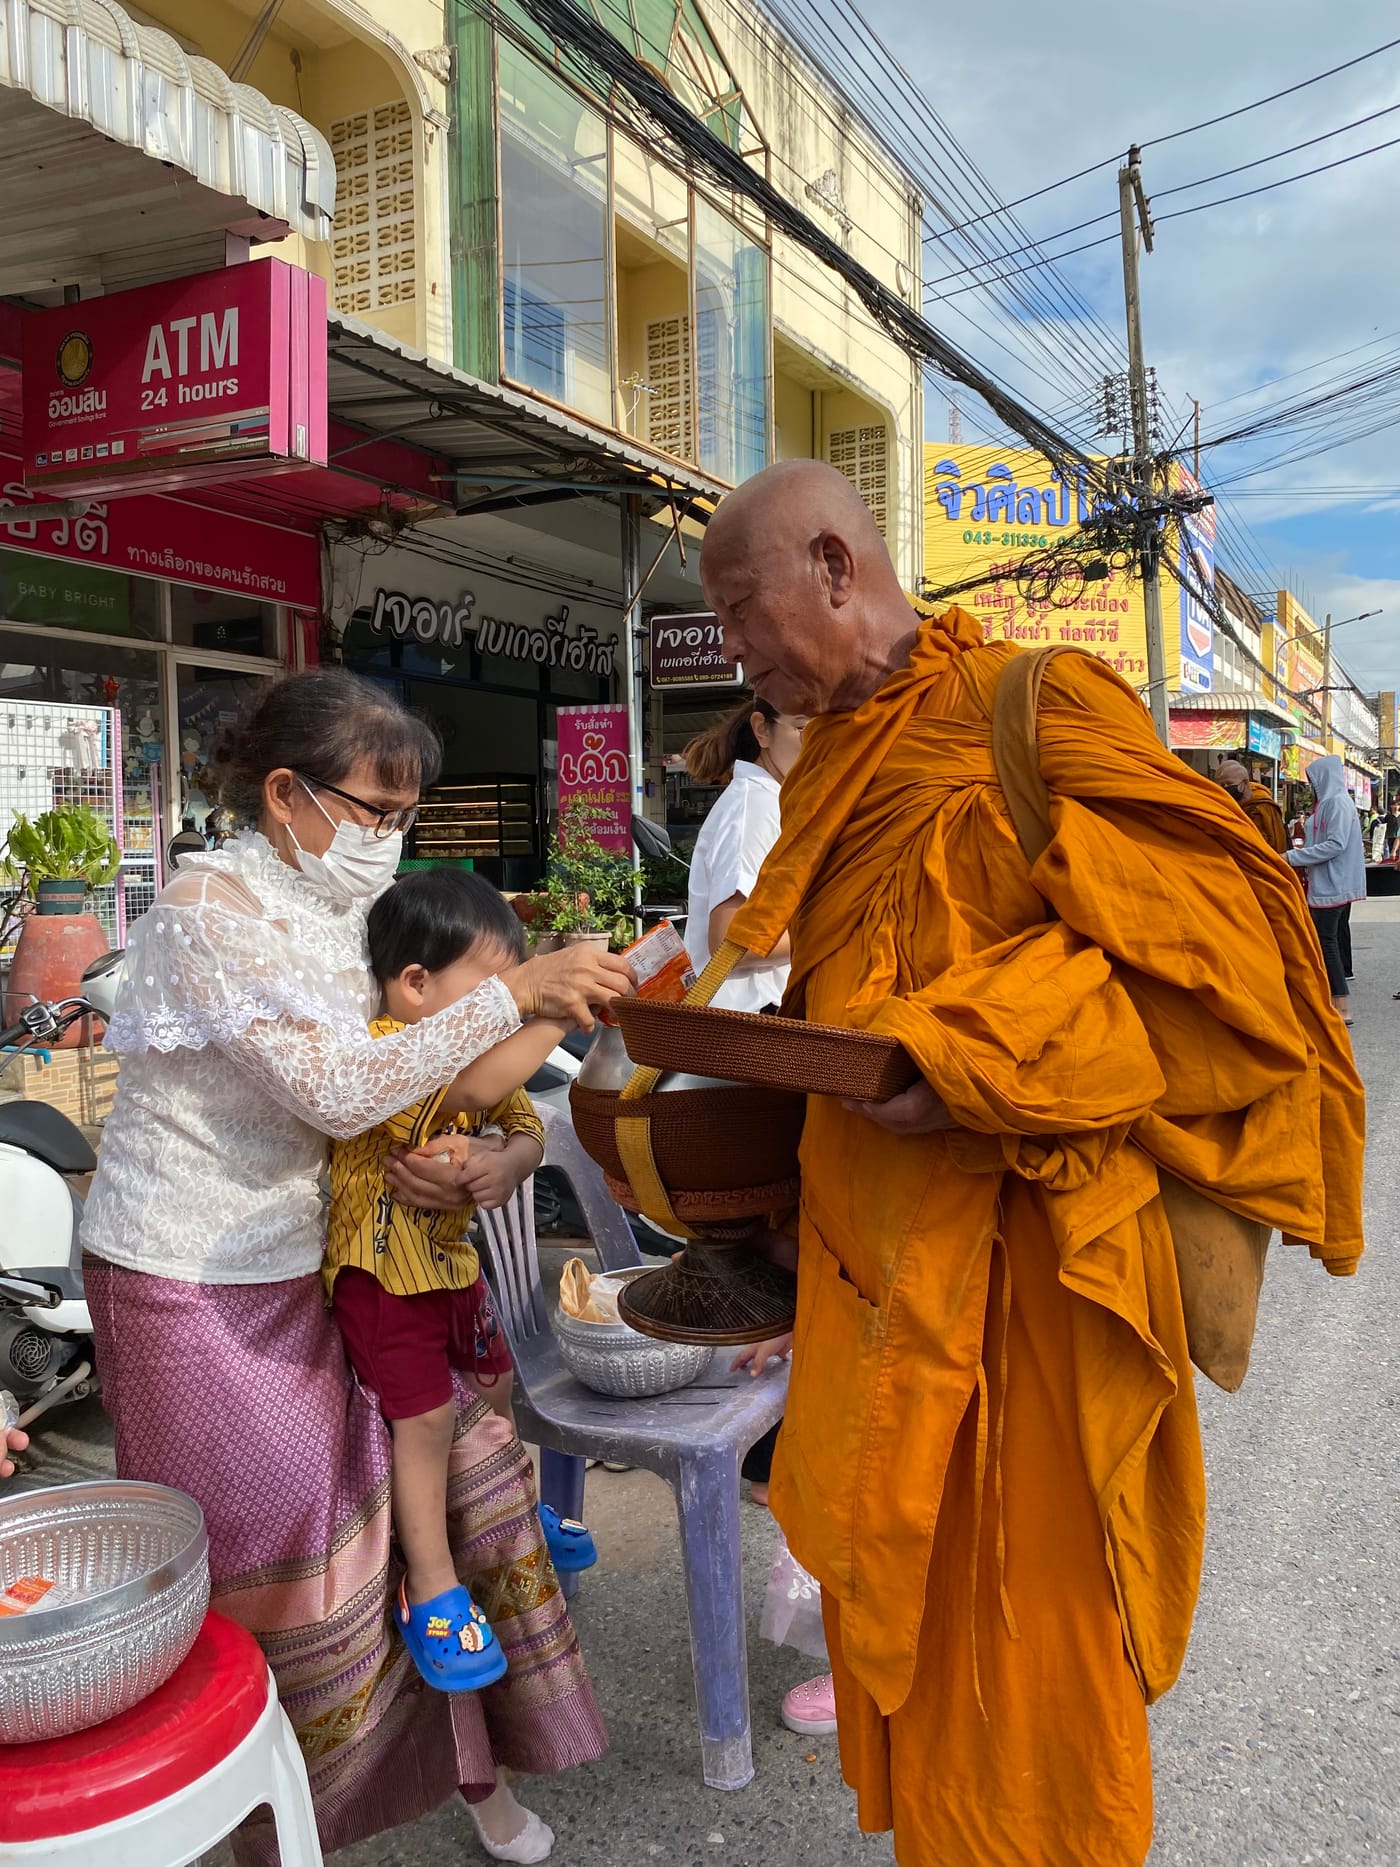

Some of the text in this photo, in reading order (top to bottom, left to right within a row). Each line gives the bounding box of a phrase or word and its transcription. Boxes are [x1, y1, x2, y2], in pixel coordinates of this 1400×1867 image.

[141, 307, 239, 384] ATM
[48, 387, 107, 419] ออมสิน
[141, 377, 239, 411] 24 hours
[127, 546, 287, 593] ทางเลือกของคนรักสวย
[18, 582, 116, 609] BABY BRIGHT
[372, 590, 619, 677] เจอาร์ เบเกอรี่เฮ้าส์
[656, 625, 724, 649] เจอาร
[1059, 619, 1120, 642] ท่อพีวีซี
[660, 648, 728, 668] เบเกอรี่เฮ้าส
[574, 716, 613, 730] รับสั่งทำ
[560, 732, 630, 785] เค้ก
